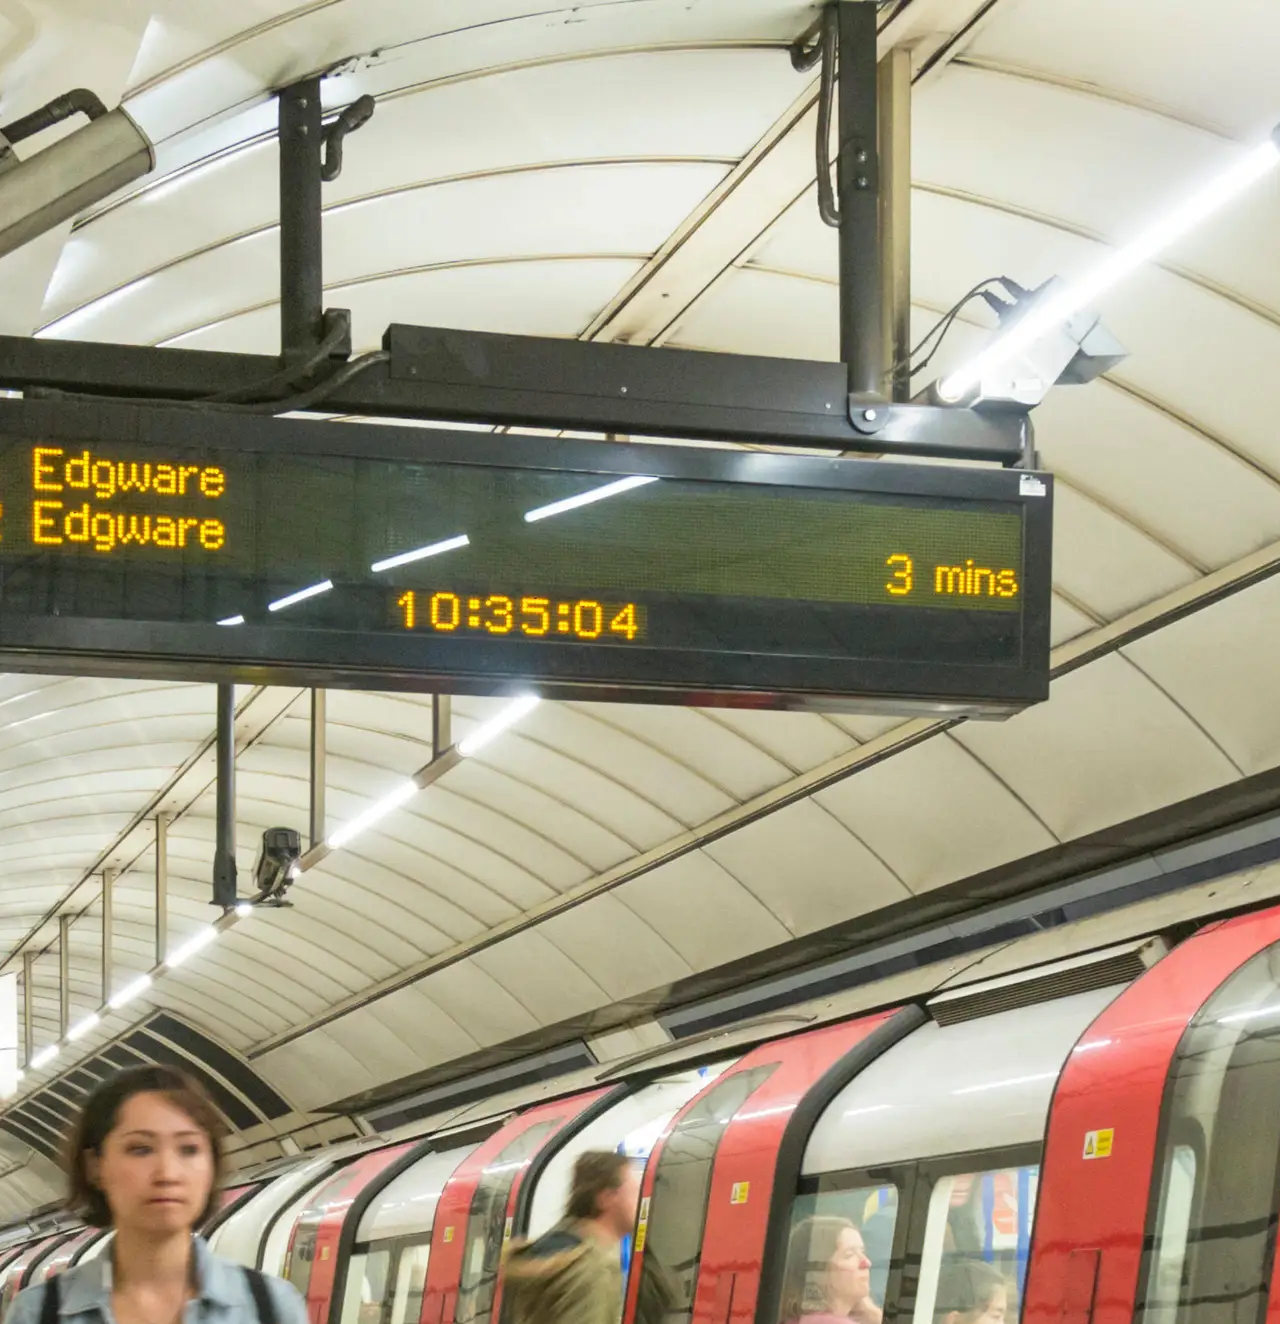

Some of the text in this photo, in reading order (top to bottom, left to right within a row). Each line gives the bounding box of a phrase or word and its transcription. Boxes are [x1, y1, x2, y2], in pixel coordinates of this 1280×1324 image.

[33, 447, 225, 498] Edgware
[33, 500, 225, 551] Edgware
[886, 553, 913, 595] 3
[935, 559, 1018, 597] mins
[398, 590, 638, 640] 10:35:04
